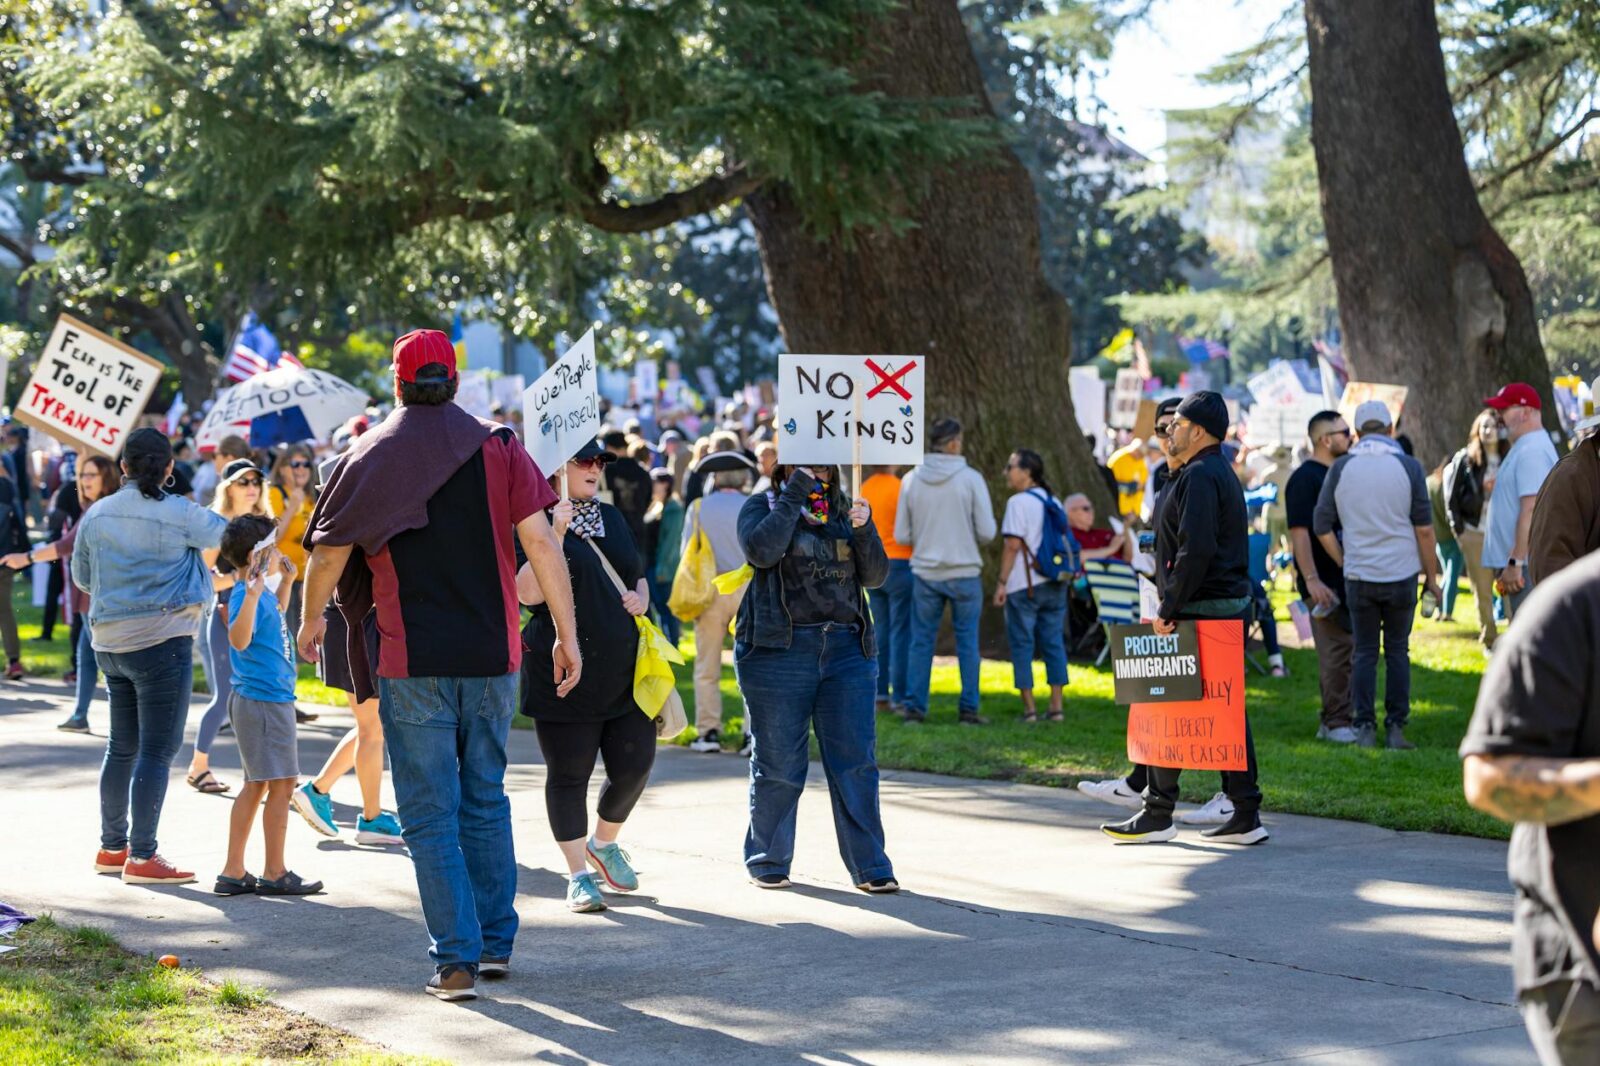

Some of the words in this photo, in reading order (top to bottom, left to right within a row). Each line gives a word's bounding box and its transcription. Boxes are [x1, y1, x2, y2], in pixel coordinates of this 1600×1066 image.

[59, 330, 96, 367] FEAR
[117, 361, 143, 392] THE
[51, 358, 99, 402] TOOL
[103, 395, 133, 416] OF
[796, 365, 854, 400] NO
[31, 383, 120, 446] TYRANTS
[1124, 634, 1179, 656] PROTECT
[1115, 655, 1197, 679] IMMIGRANTS
[1164, 715, 1215, 740] LIBERTY
